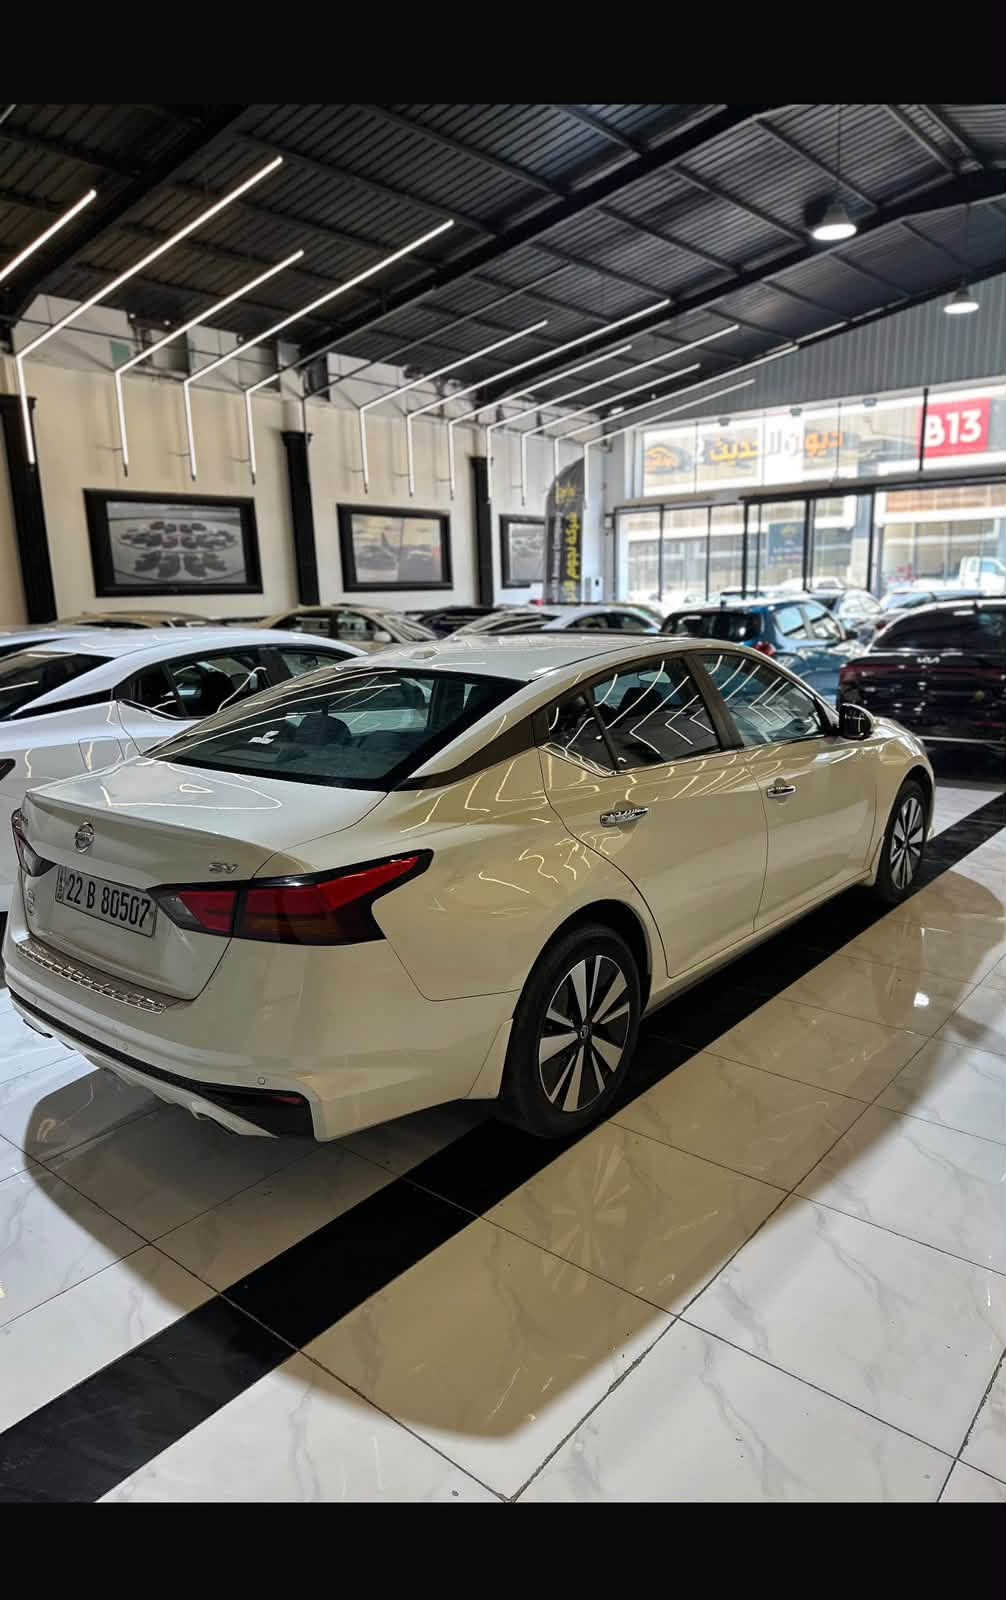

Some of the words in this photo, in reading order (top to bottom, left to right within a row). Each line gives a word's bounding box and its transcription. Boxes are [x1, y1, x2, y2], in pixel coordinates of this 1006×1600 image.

[924, 408, 982, 448] B13
[66, 873, 84, 905] 22
[86, 881, 96, 909] B
[100, 886, 152, 929] 80507
